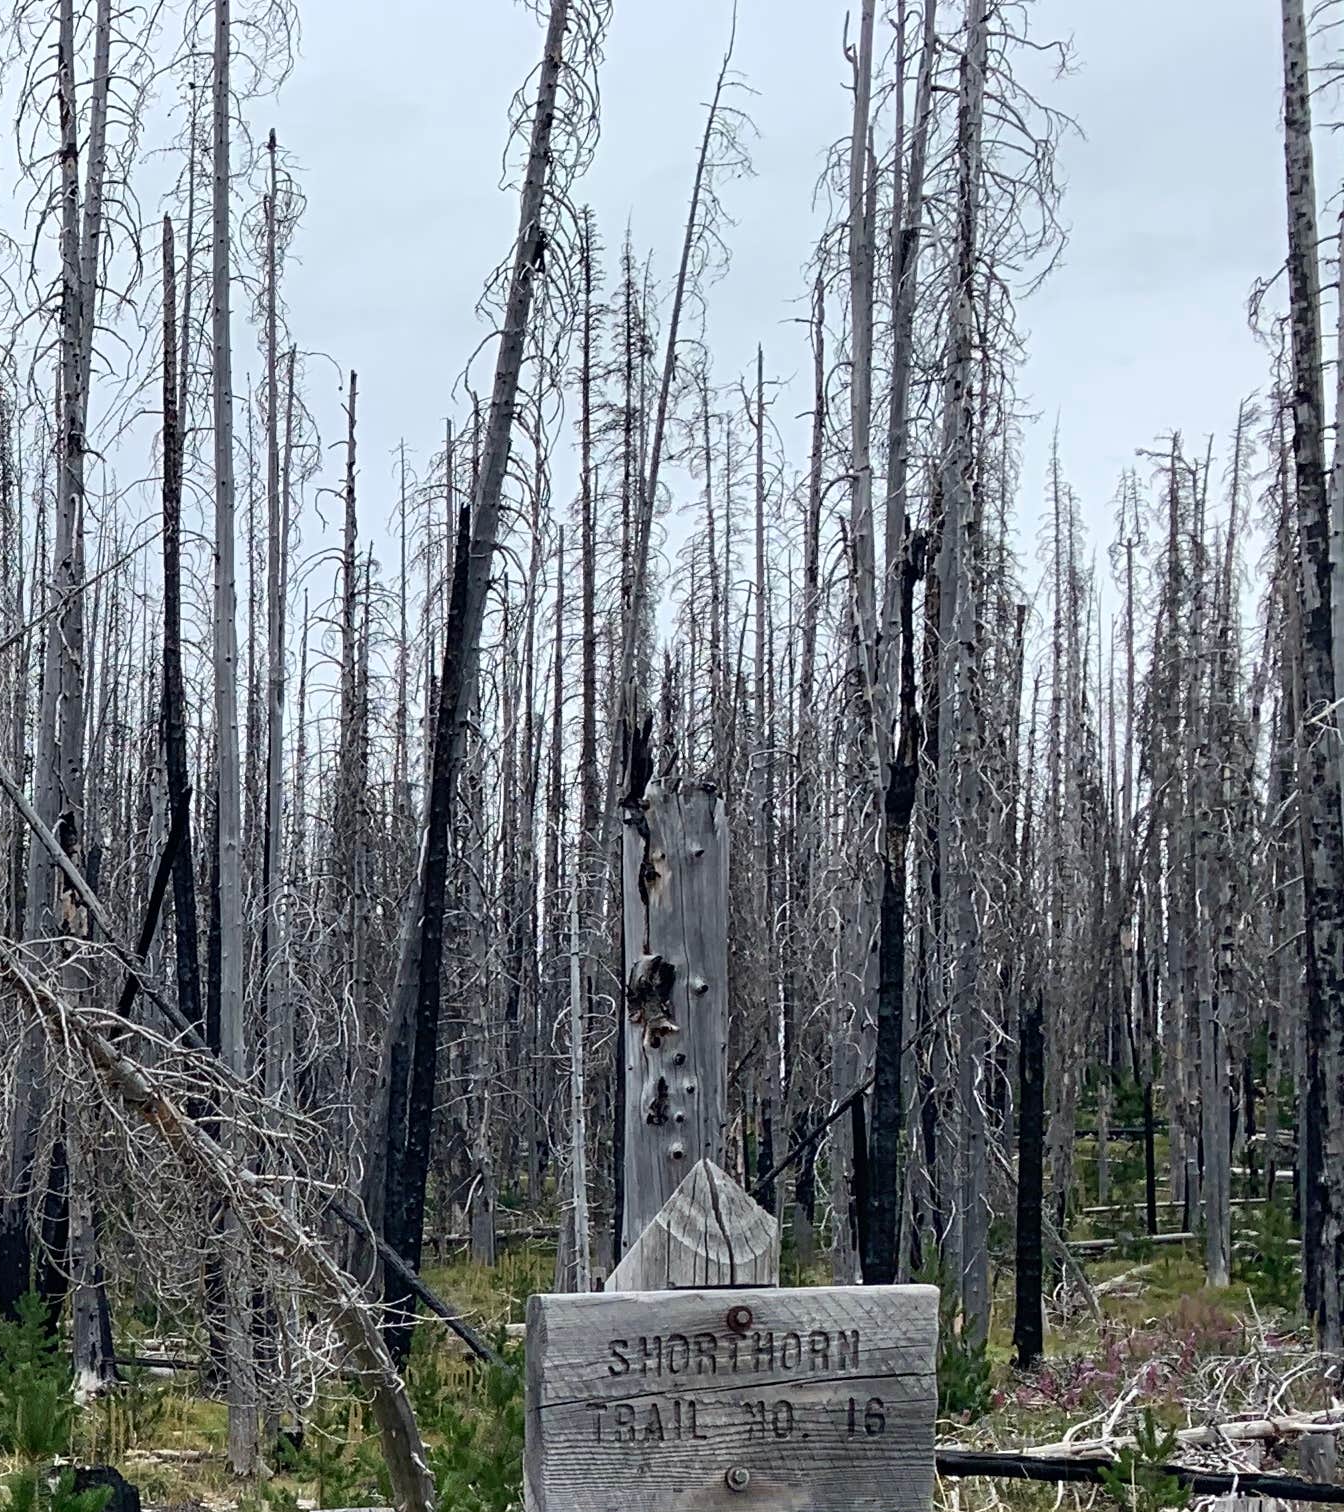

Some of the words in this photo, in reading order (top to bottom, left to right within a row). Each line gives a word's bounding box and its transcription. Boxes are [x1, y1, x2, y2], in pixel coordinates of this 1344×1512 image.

[607, 1329, 861, 1378] SHORTHORN
[585, 1399, 709, 1445] TRAIL
[741, 1399, 810, 1443] NO.
[847, 1395, 887, 1440] 16
